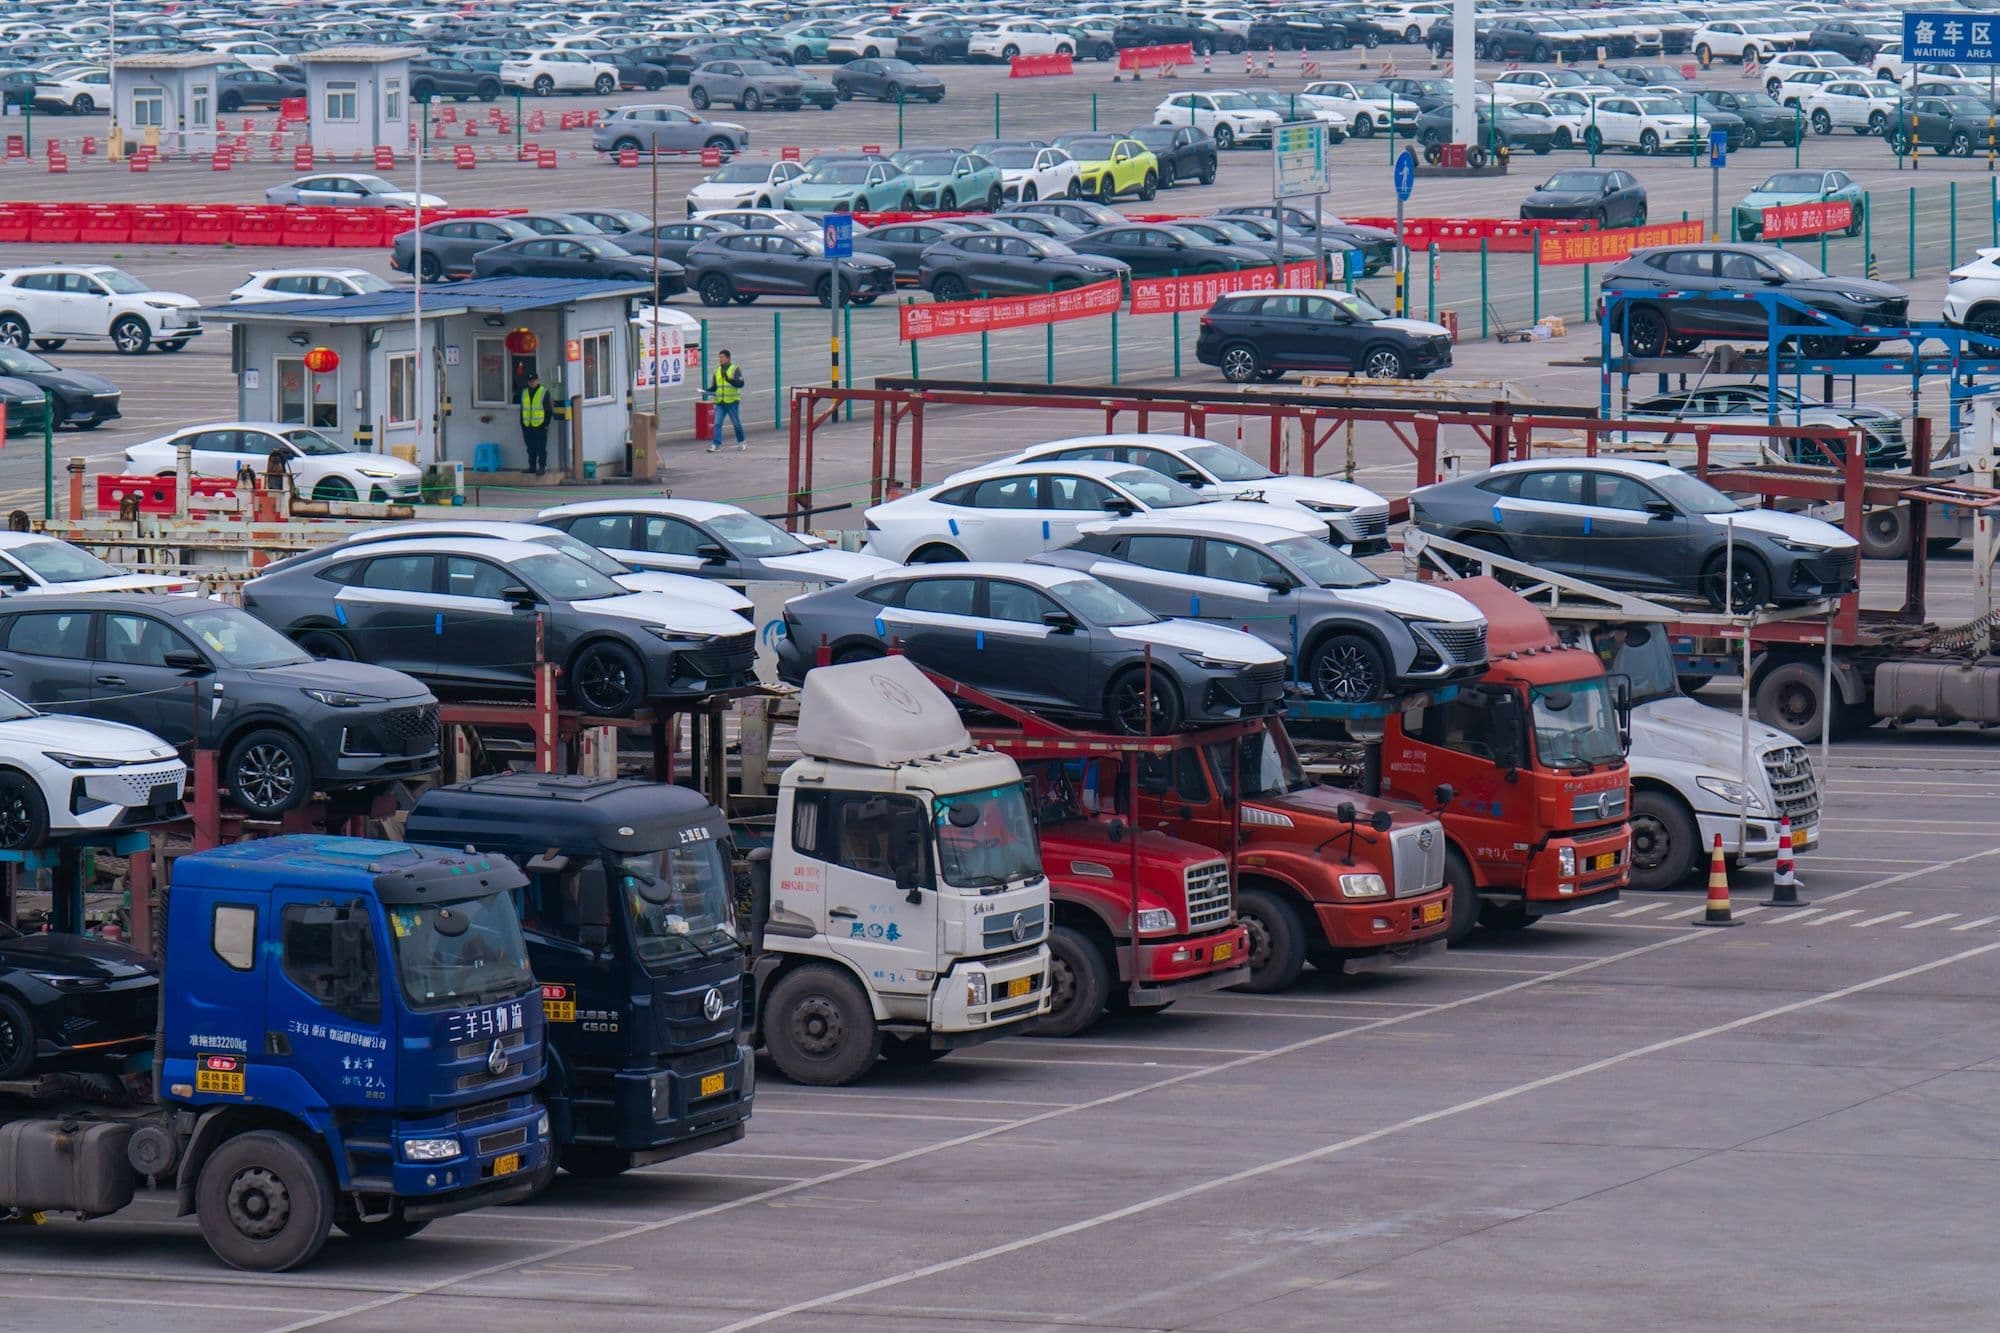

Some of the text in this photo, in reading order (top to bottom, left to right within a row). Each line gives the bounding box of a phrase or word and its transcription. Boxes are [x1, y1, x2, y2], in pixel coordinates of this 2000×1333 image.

[1914, 20, 1992, 45] 备车区
[1913, 48, 1992, 58] WAITING AREA
[1565, 237, 1599, 258] 突出重点
[449, 1003, 522, 1042] 三羊马物流
[582, 1022, 618, 1032] C500
